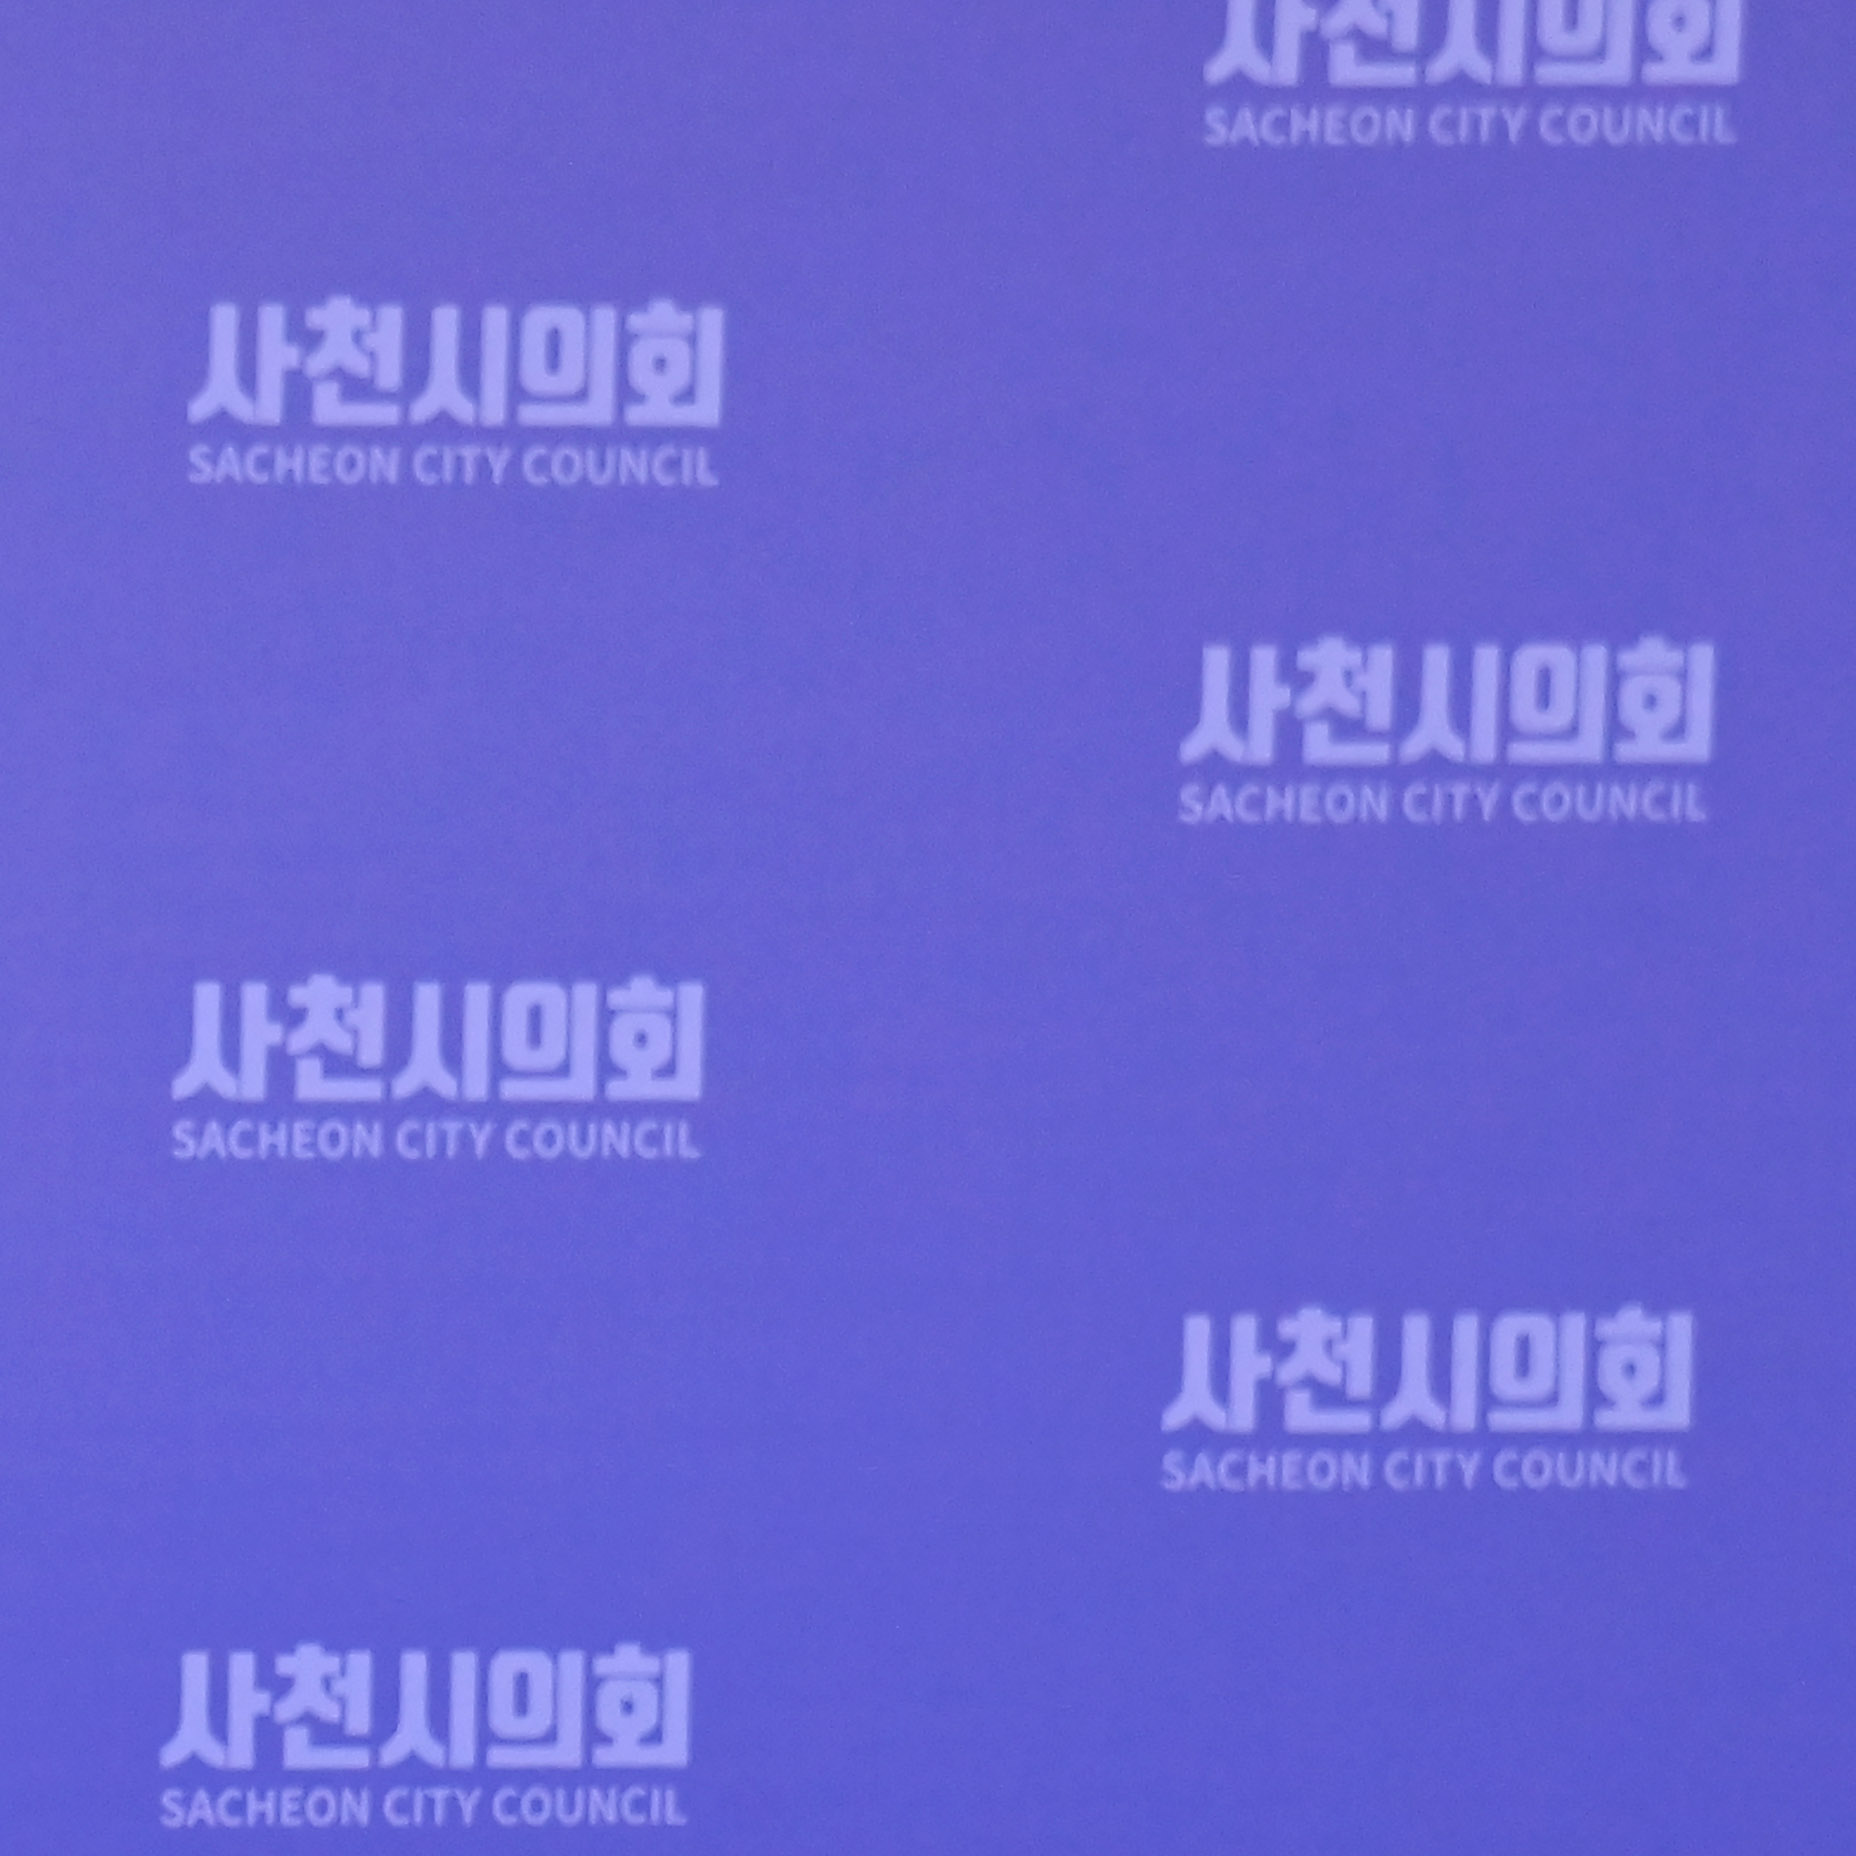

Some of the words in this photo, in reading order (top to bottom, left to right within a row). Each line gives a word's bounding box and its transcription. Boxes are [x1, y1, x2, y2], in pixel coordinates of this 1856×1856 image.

[1205, 104, 1416, 146] SACHEON
[1428, 103, 1528, 145] CITY
[1539, 103, 1735, 145] COUNCIL
[188, 294, 727, 428] 사천시의회
[189, 443, 400, 485] SACHEON
[413, 444, 512, 485] CITY
[522, 444, 718, 487] COUNCIL
[1179, 634, 1717, 766] 사천시의회
[1179, 782, 1391, 824] SACHEON
[1402, 781, 1501, 823] CITY
[1512, 779, 1707, 823] COUNCIL
[171, 972, 706, 1103] 사천시의회
[172, 1119, 383, 1160] SACHEON
[395, 1118, 494, 1160] CITY
[504, 1118, 701, 1160] COUNCIL
[1161, 1302, 1696, 1434] 사천시의회
[1162, 1449, 1372, 1491] SACHEON
[1384, 1449, 1482, 1490] CITY
[1493, 1448, 1686, 1489] COUNCIL
[159, 1642, 692, 1771] 사천시의회
[161, 1787, 371, 1828] SACHEON
[383, 1786, 481, 1827] CITY
[492, 1785, 687, 1826] COUNCIL
